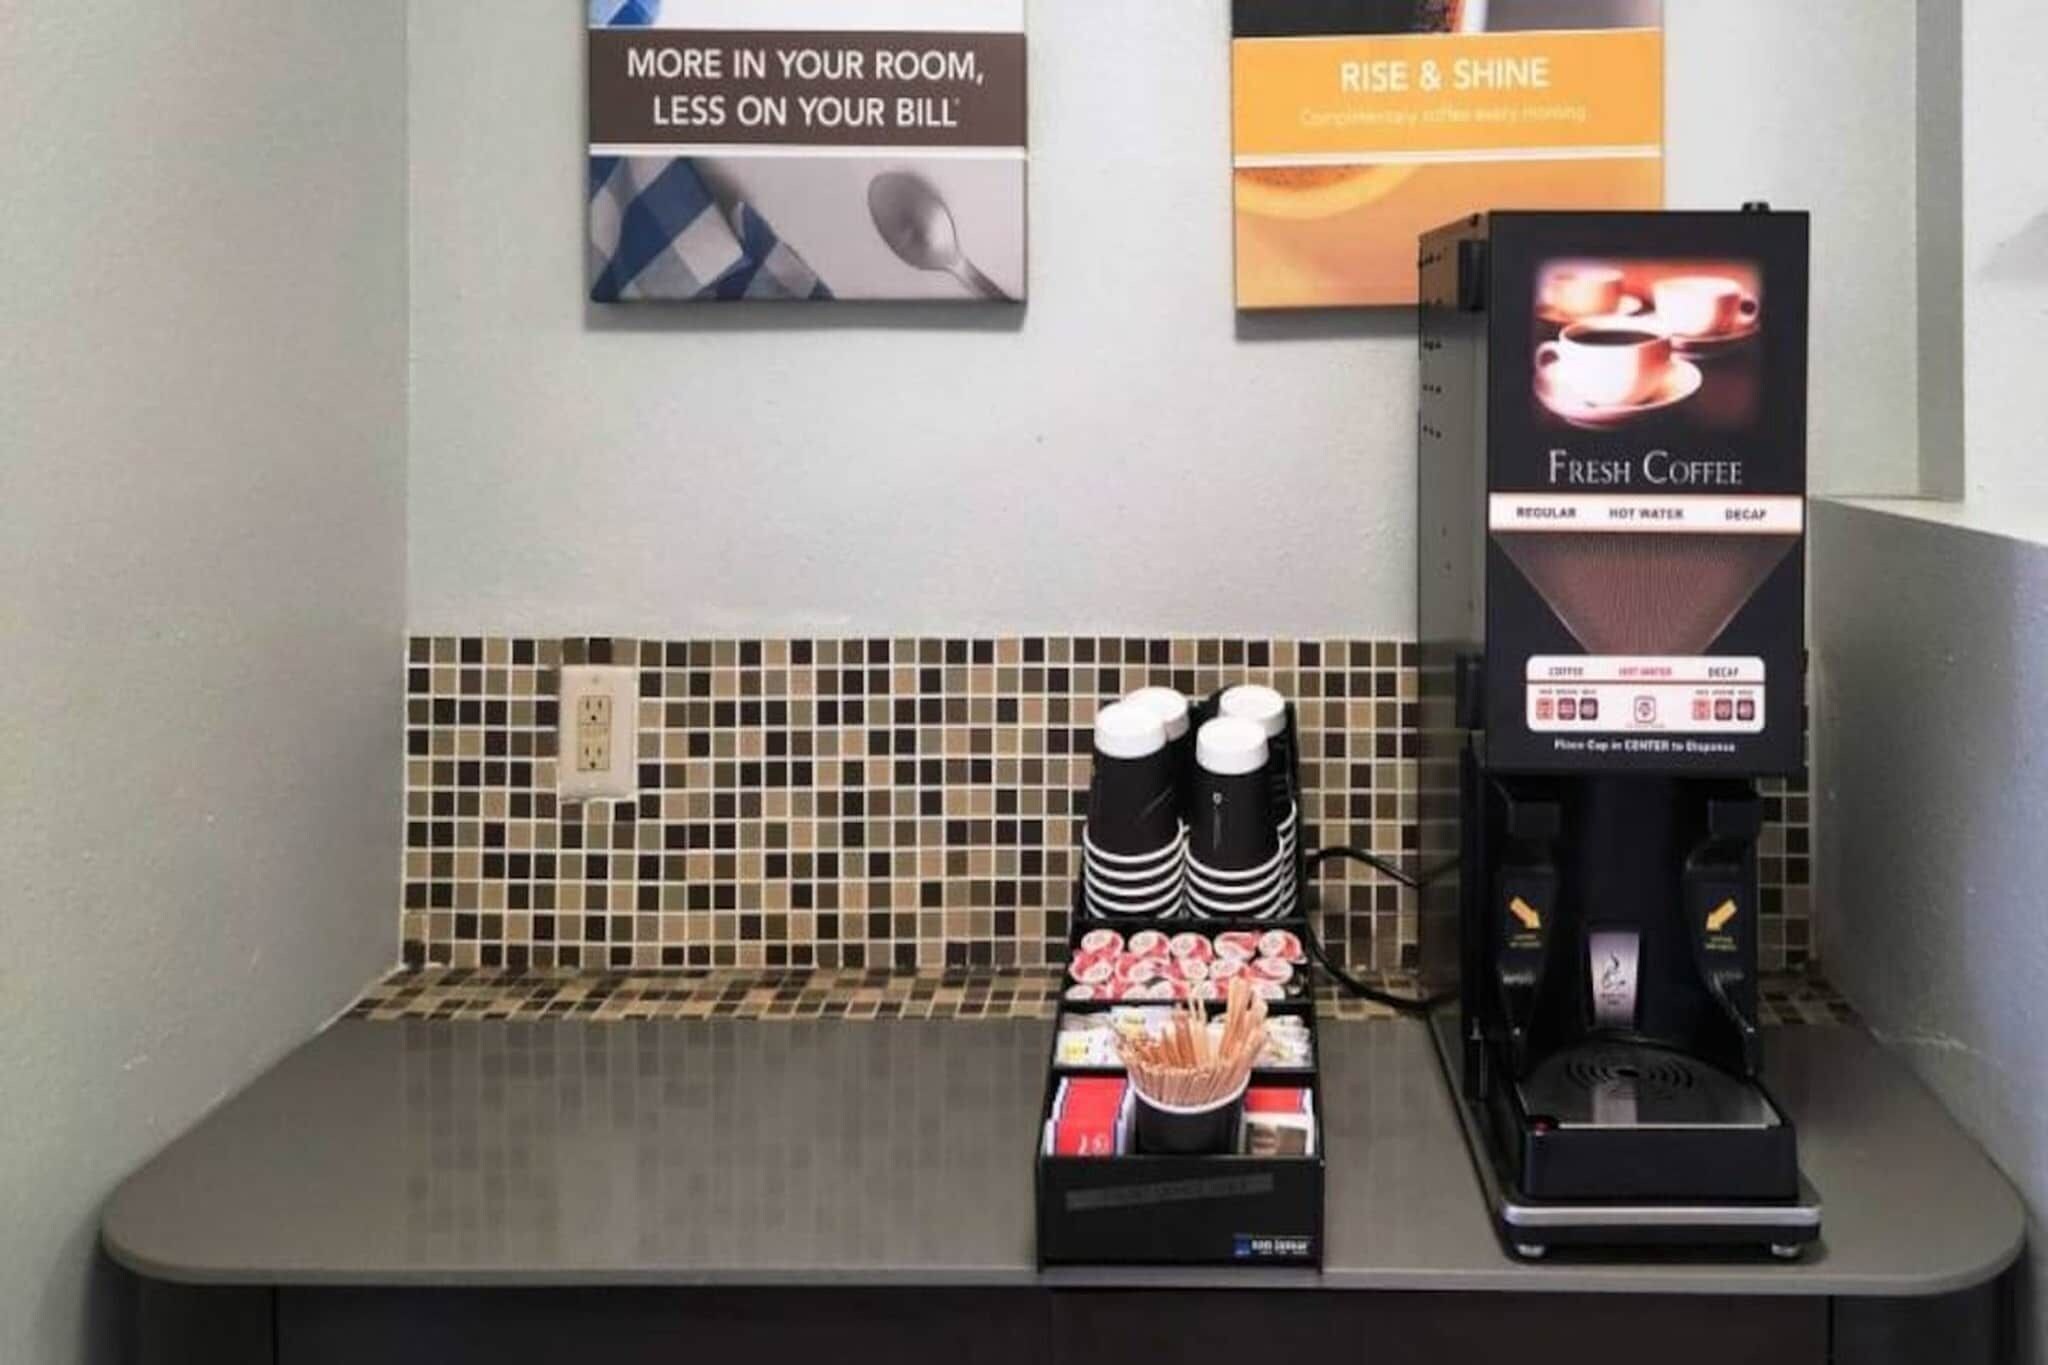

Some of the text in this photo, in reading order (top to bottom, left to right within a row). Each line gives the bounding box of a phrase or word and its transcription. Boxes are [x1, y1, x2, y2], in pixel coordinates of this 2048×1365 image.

[627, 48, 985, 86] MORE IN YOUR ROOM,
[1340, 57, 1550, 91] RISE & SHINE
[653, 95, 726, 126] LESS
[737, 96, 787, 127] ON
[799, 97, 885, 127] YOUR
[1516, 506, 1576, 519] REGULAR
[1609, 507, 1684, 520] HOT WATER
[1725, 508, 1767, 521] DECAF
[1707, 666, 1740, 678] DECAF
[1625, 740, 1670, 752] CENTER
